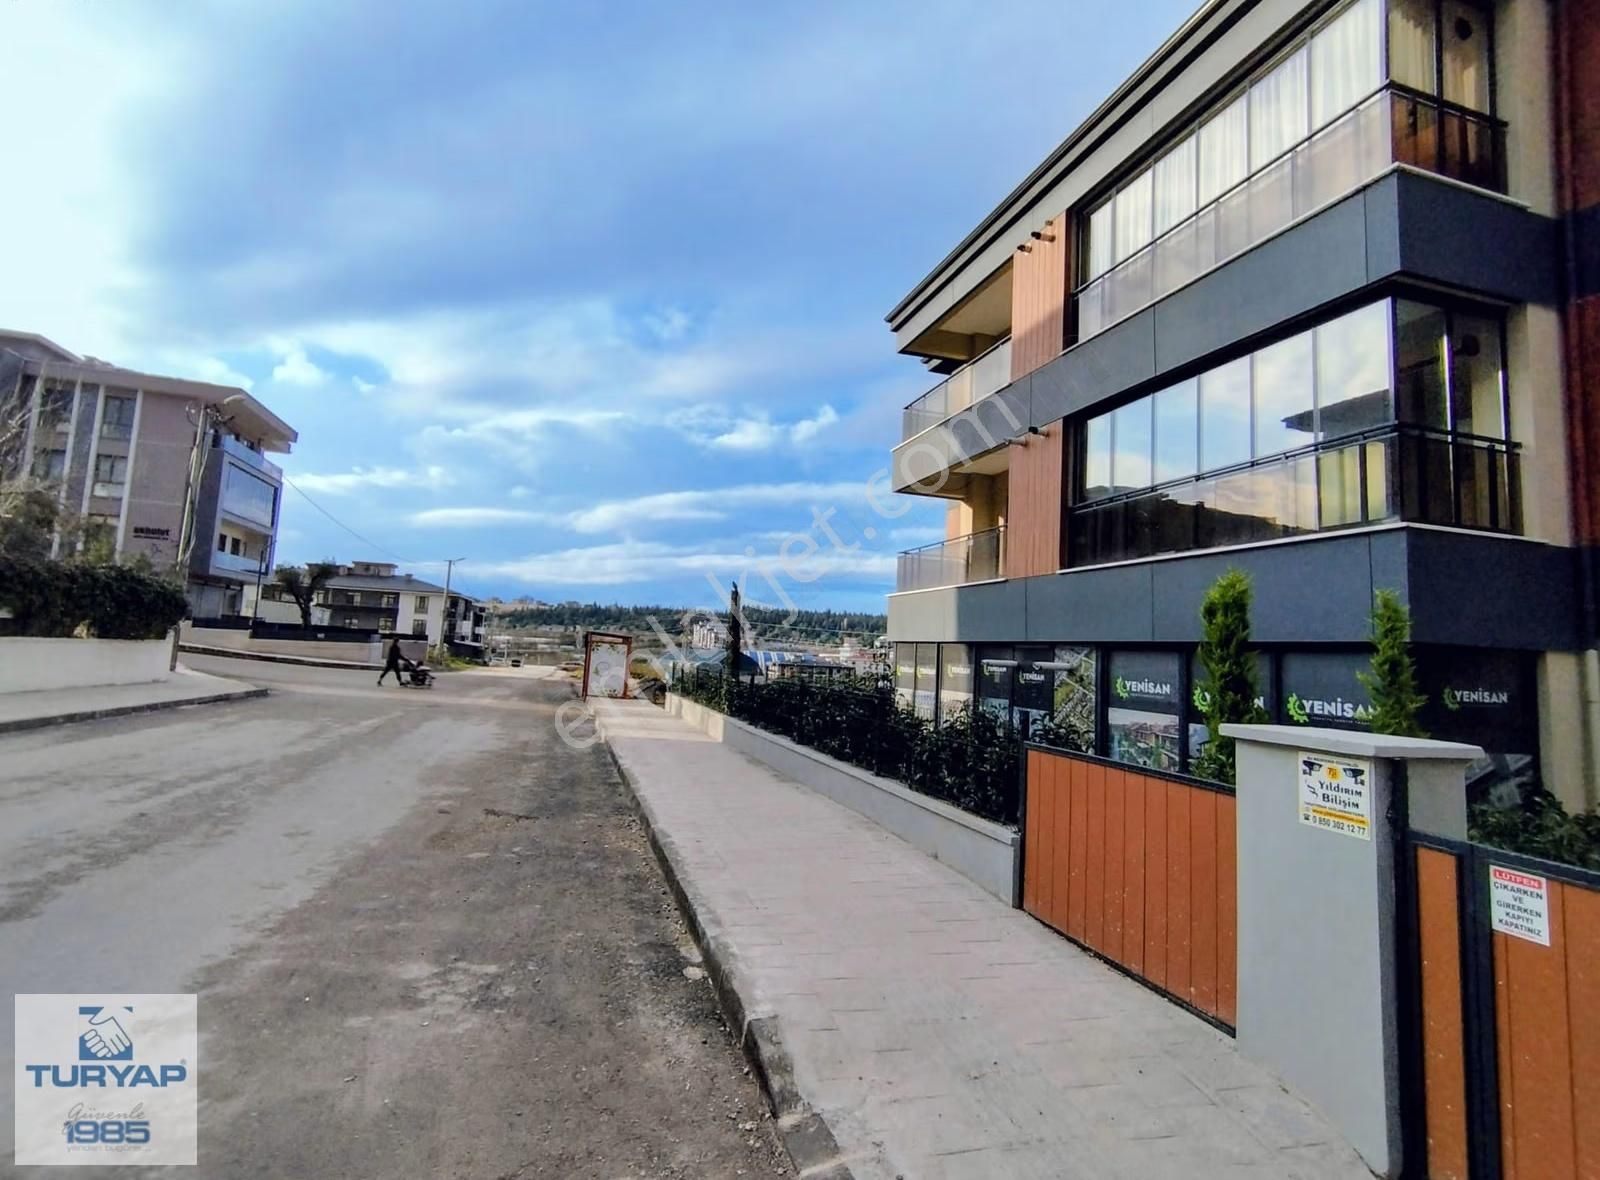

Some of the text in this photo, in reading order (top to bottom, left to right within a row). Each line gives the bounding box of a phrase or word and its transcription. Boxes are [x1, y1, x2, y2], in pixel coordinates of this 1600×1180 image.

[1125, 678, 1171, 695] YENİSAN
[1454, 687, 1508, 704] YENİSAN
[1346, 825, 1355, 833] 12
[1357, 827, 1366, 836] 77
[1512, 895, 1524, 904] VE
